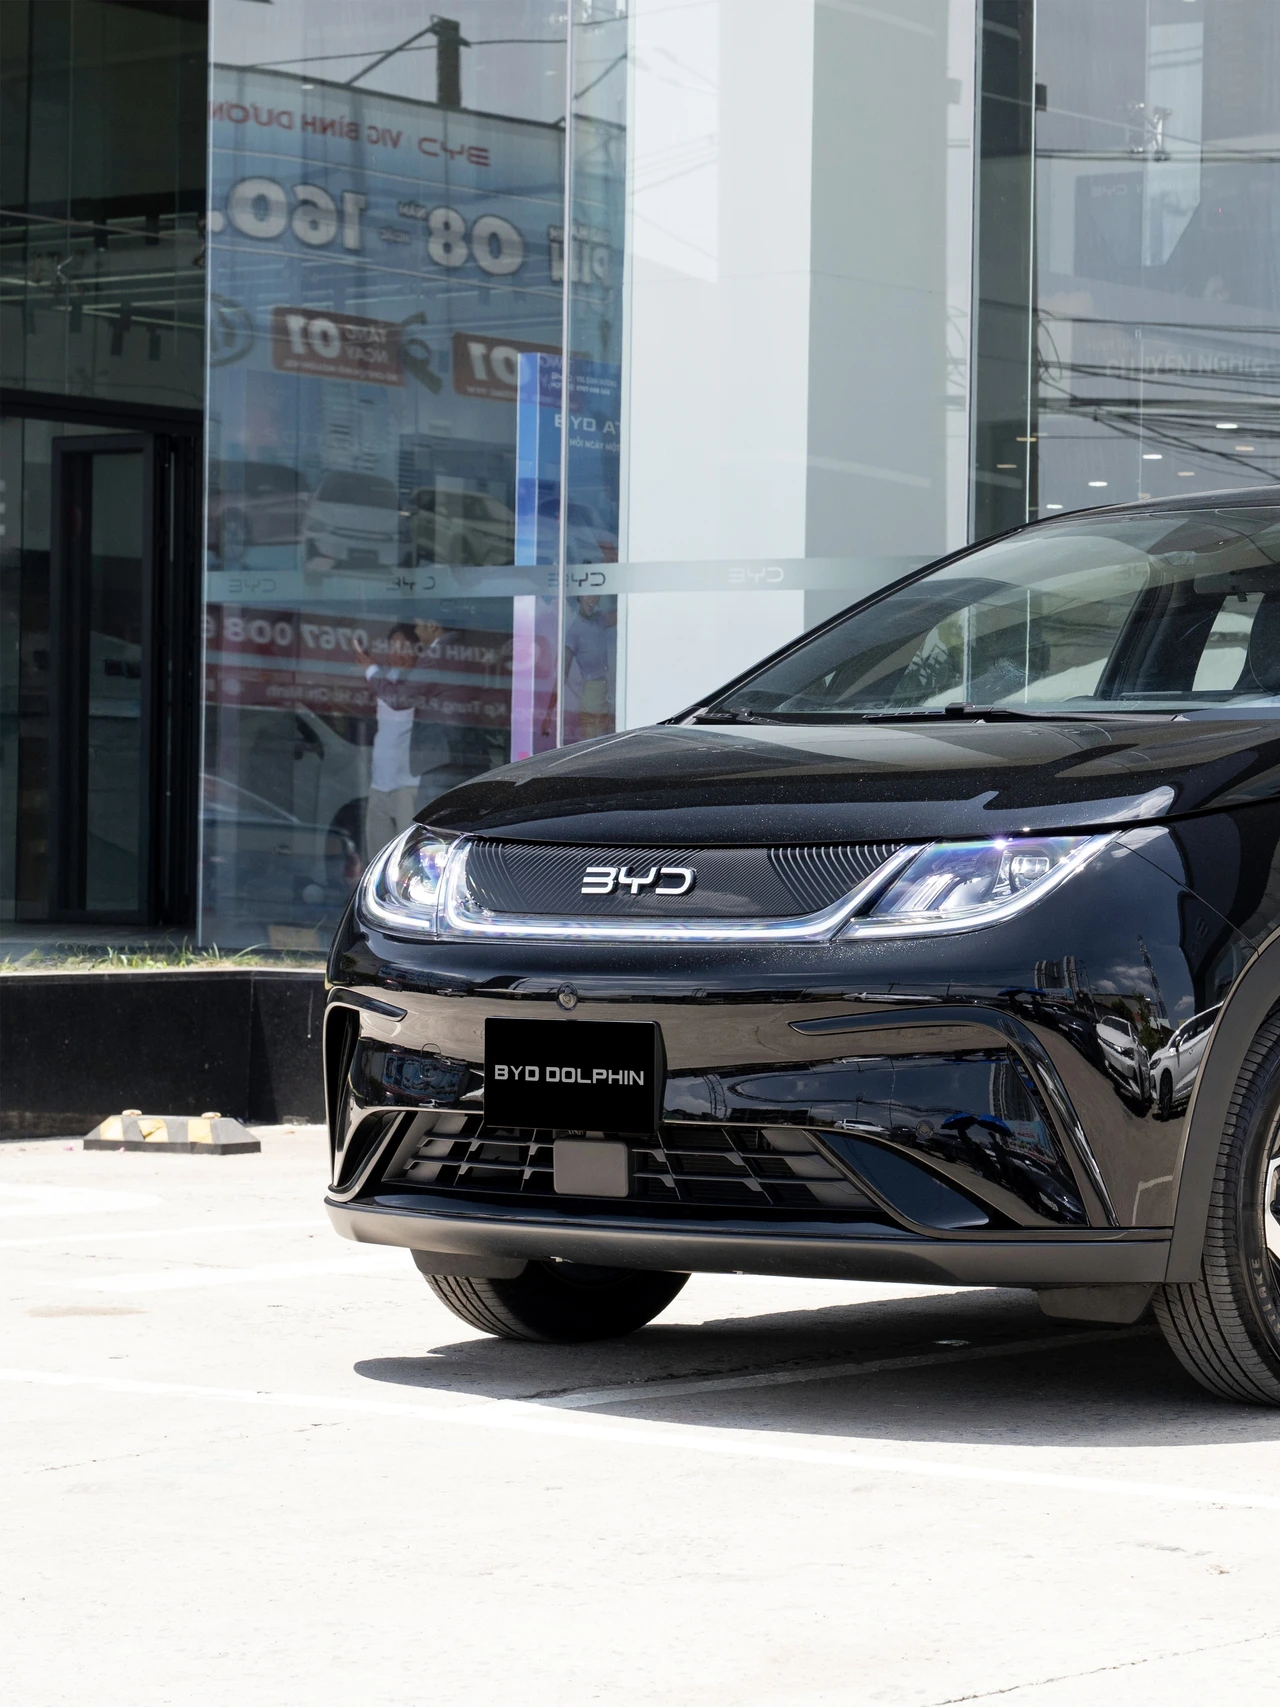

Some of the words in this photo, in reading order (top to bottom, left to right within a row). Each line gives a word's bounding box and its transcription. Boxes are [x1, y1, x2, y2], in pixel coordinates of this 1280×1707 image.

[728, 567, 785, 583] BYD
[229, 579, 276, 593] BYD
[581, 866, 697, 896] BYD
[494, 1065, 539, 1082] BYD
[545, 1066, 644, 1086] DOLPHIN
